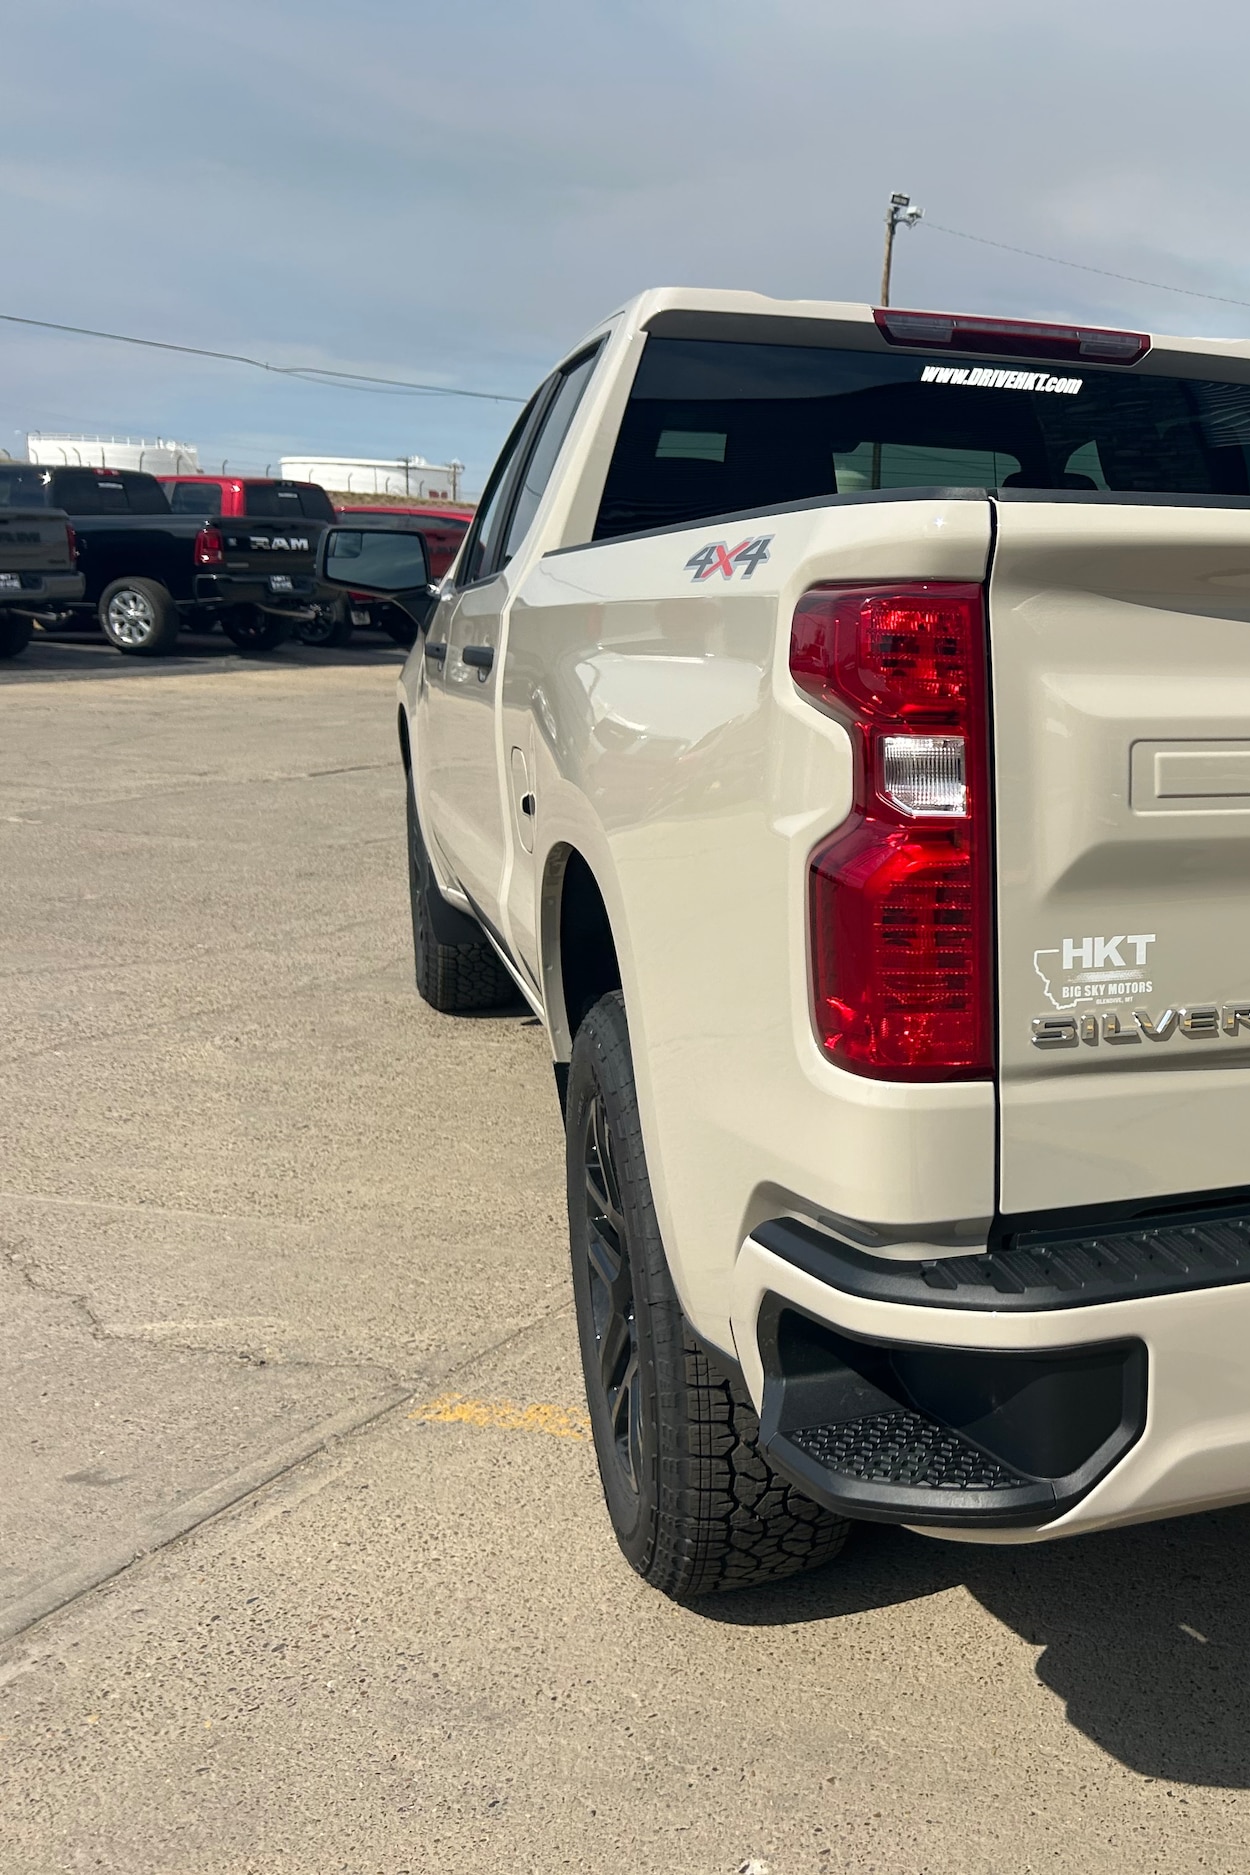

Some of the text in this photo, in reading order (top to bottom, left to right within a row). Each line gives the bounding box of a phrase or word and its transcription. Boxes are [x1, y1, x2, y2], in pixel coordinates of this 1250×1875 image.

[920, 365, 1083, 395] www.DRIVEHKT.com
[249, 536, 309, 551] RAM
[1062, 934, 1156, 970] HKT
[1062, 980, 1153, 998] BIG SKY MOTORS
